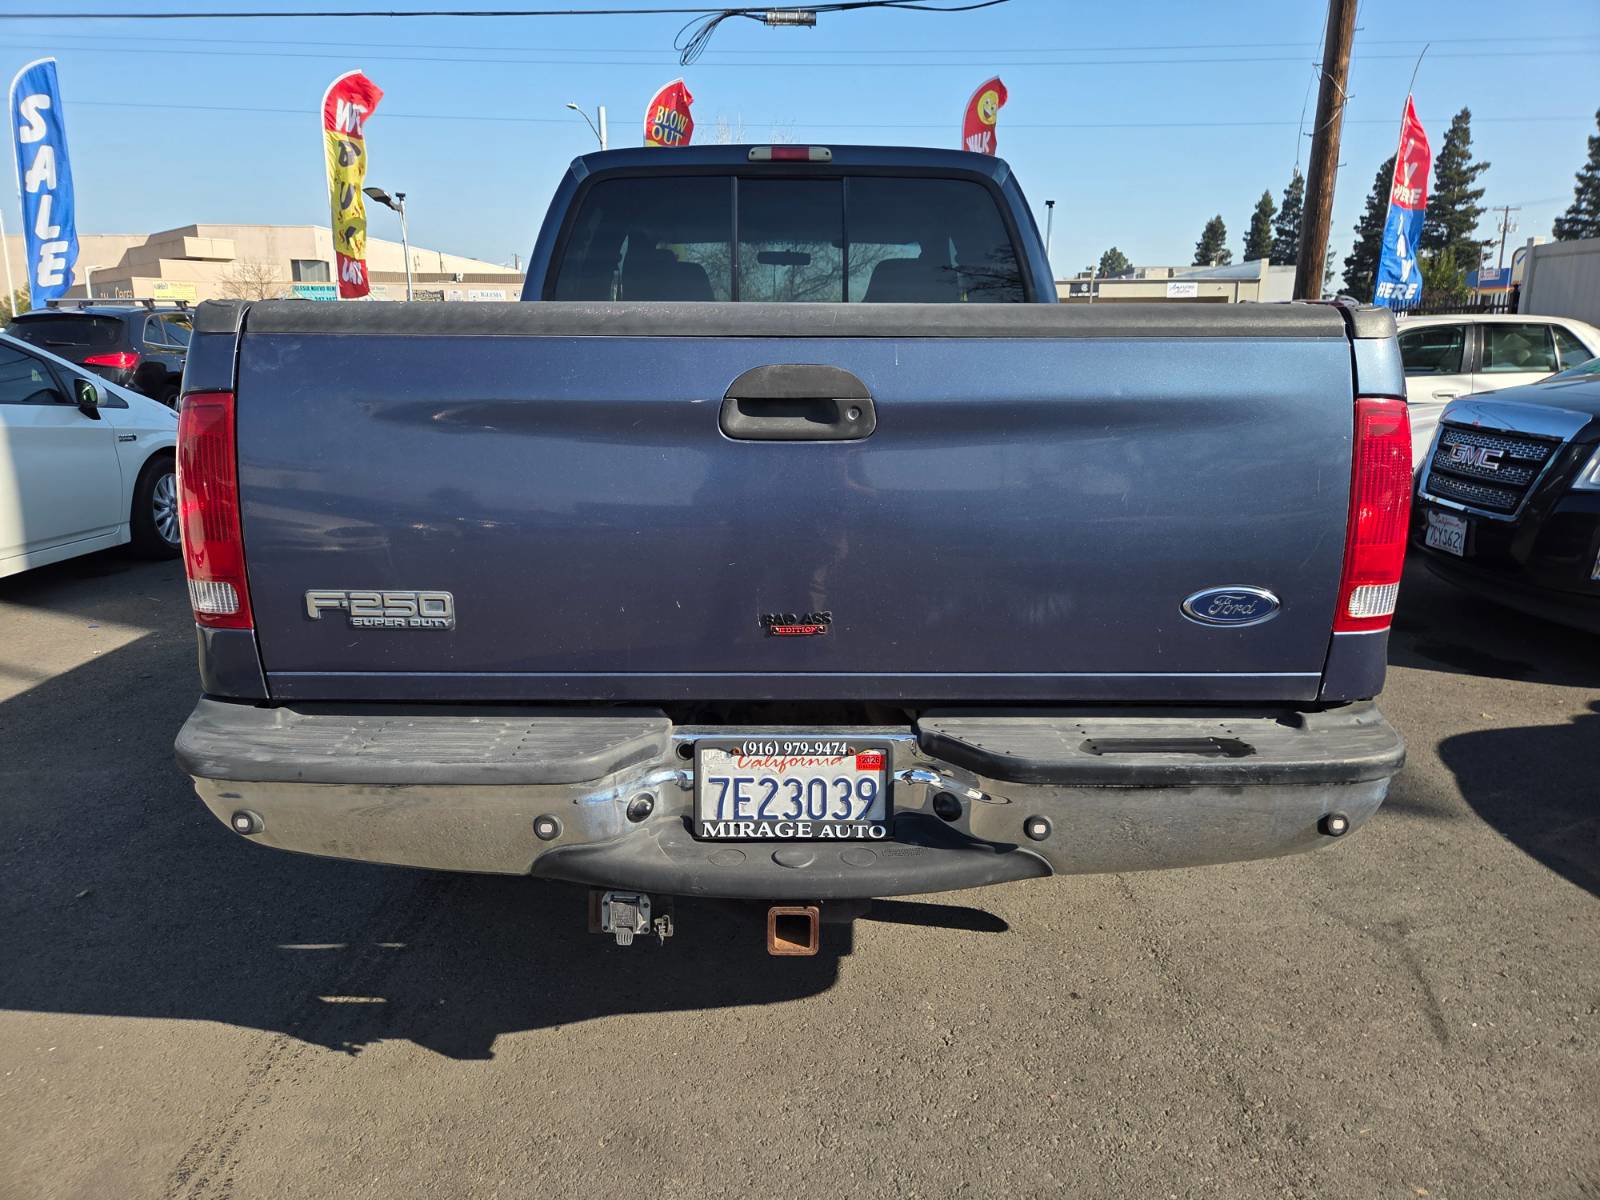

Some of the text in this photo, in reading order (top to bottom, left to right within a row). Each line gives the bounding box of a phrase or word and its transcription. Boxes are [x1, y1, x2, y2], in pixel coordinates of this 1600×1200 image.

[655, 105, 688, 133] BLOW
[652, 124, 683, 146] OUT
[20, 94, 68, 288] SALE
[1376, 281, 1418, 300] HERE
[1451, 443, 1504, 470] GMC
[305, 591, 451, 619] F-250
[1208, 594, 1258, 615] Ford
[352, 617, 452, 627] SUPER DUTY
[800, 611, 832, 625] ASS
[742, 740, 847, 756] (916) 979-9474
[737, 755, 843, 774] California
[708, 777, 878, 820] 7E23039
[702, 821, 886, 839] MIRAGE AUTO
